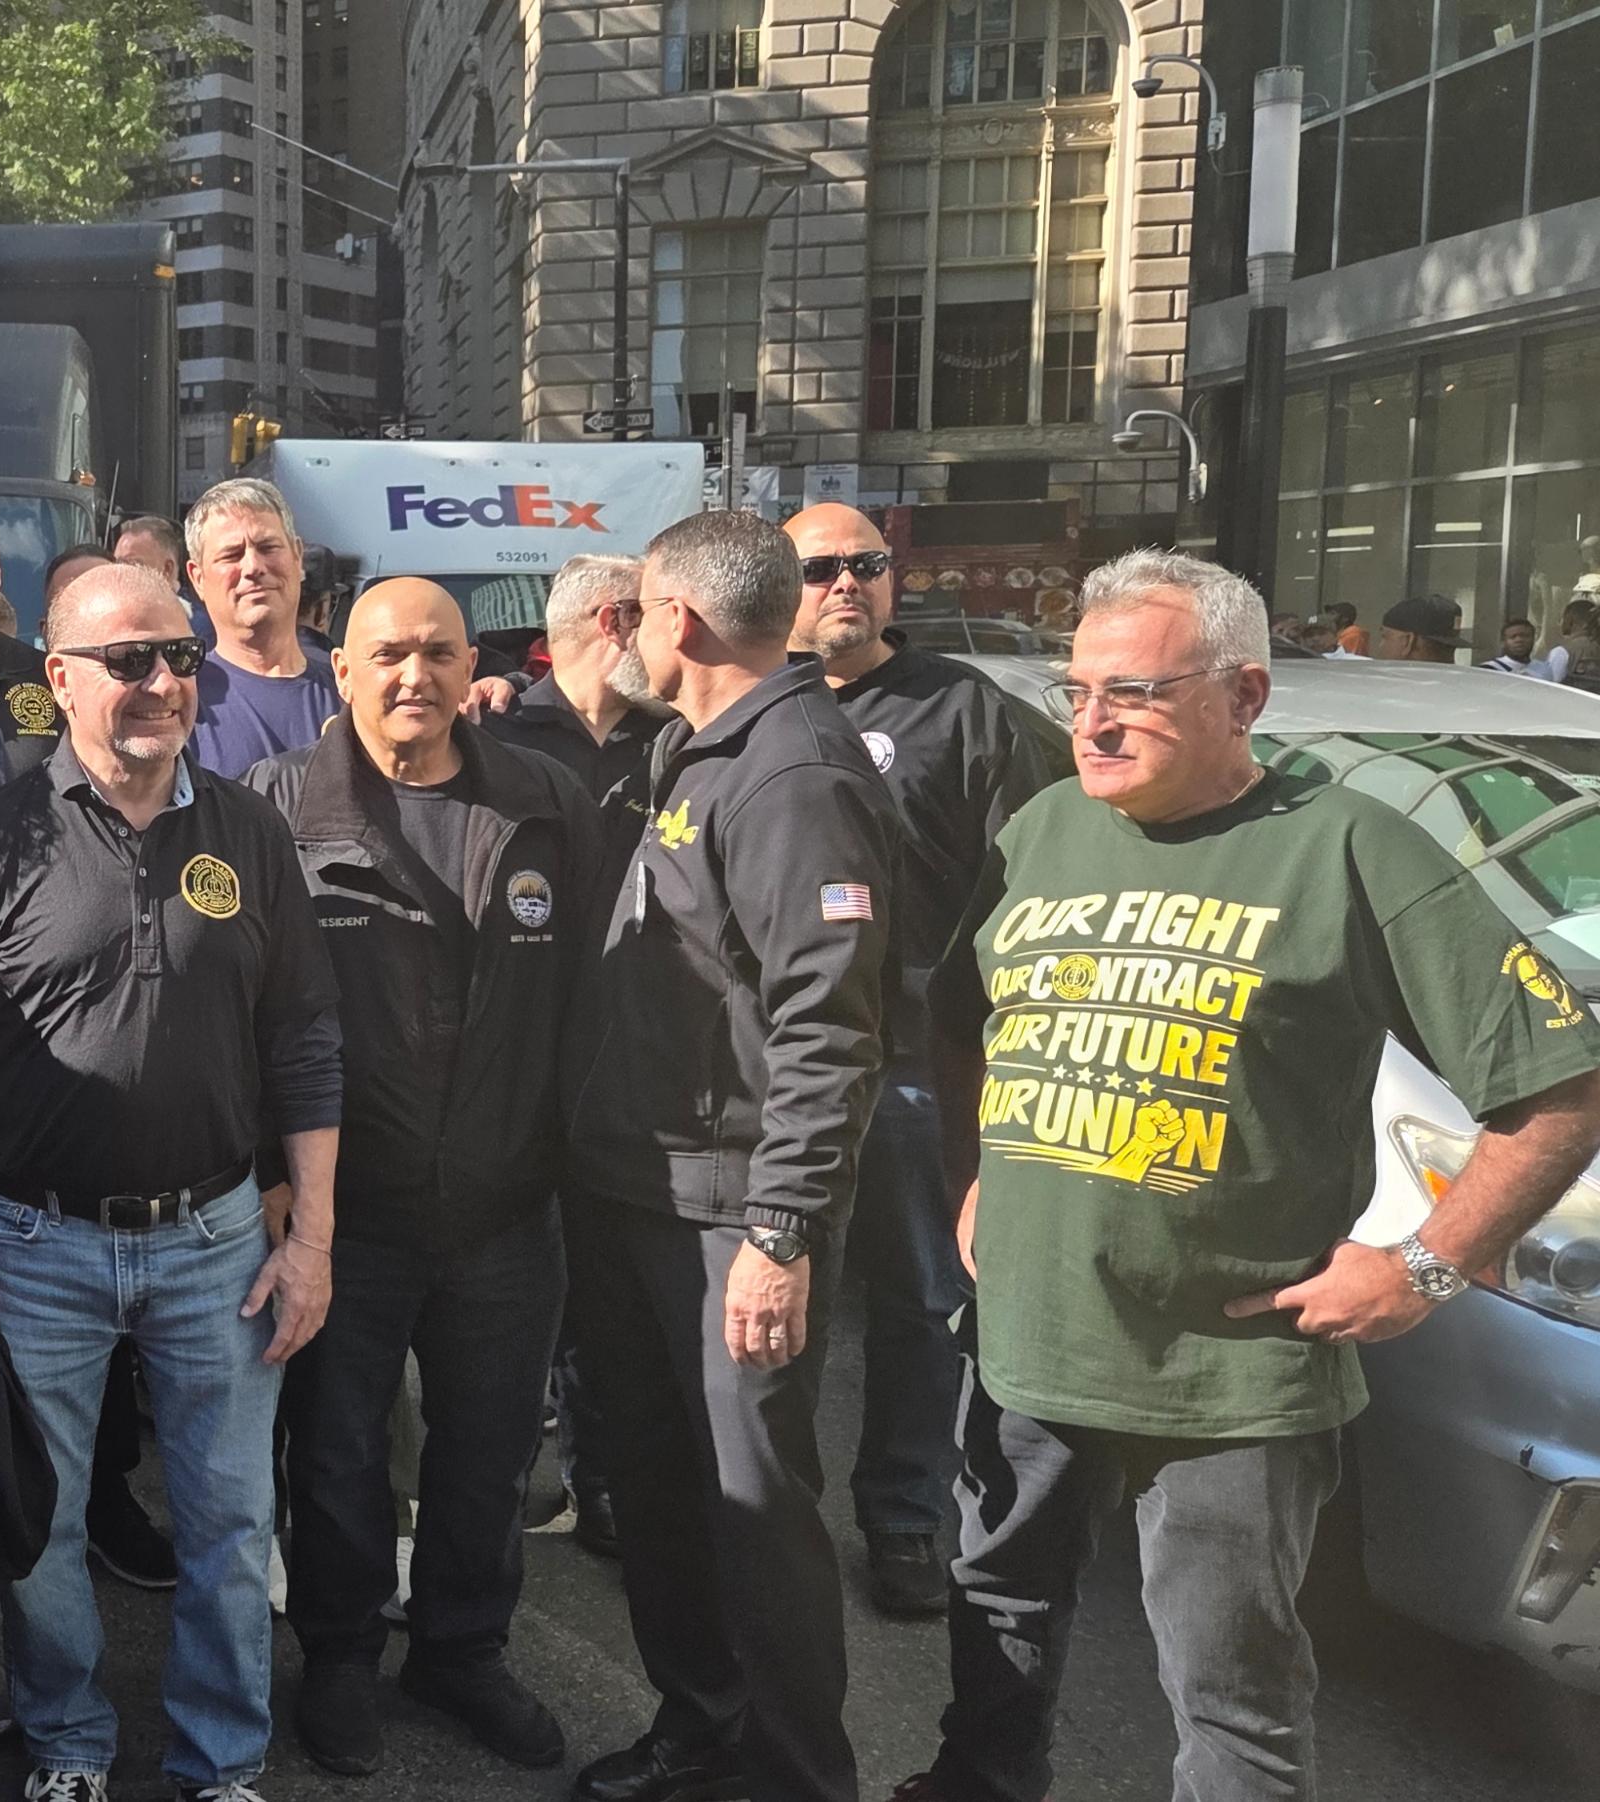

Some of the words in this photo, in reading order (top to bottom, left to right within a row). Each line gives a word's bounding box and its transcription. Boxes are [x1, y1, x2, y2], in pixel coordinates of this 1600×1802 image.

[591, 416, 614, 429] ONE
[386, 485, 612, 534] FedEx
[496, 551, 549, 563] 532091
[318, 916, 370, 928] ESIDENT
[992, 893, 1107, 955] OUR
[1100, 891, 1281, 961] FIGHT
[1500, 942, 1528, 975] MICHAEL
[991, 964, 1033, 1004] OUR
[1028, 955, 1263, 1022] CONTRACT
[1545, 1018, 1570, 1029] EST.
[1044, 1011, 1237, 1086] FUTURE
[979, 1073, 1039, 1133] OUR
